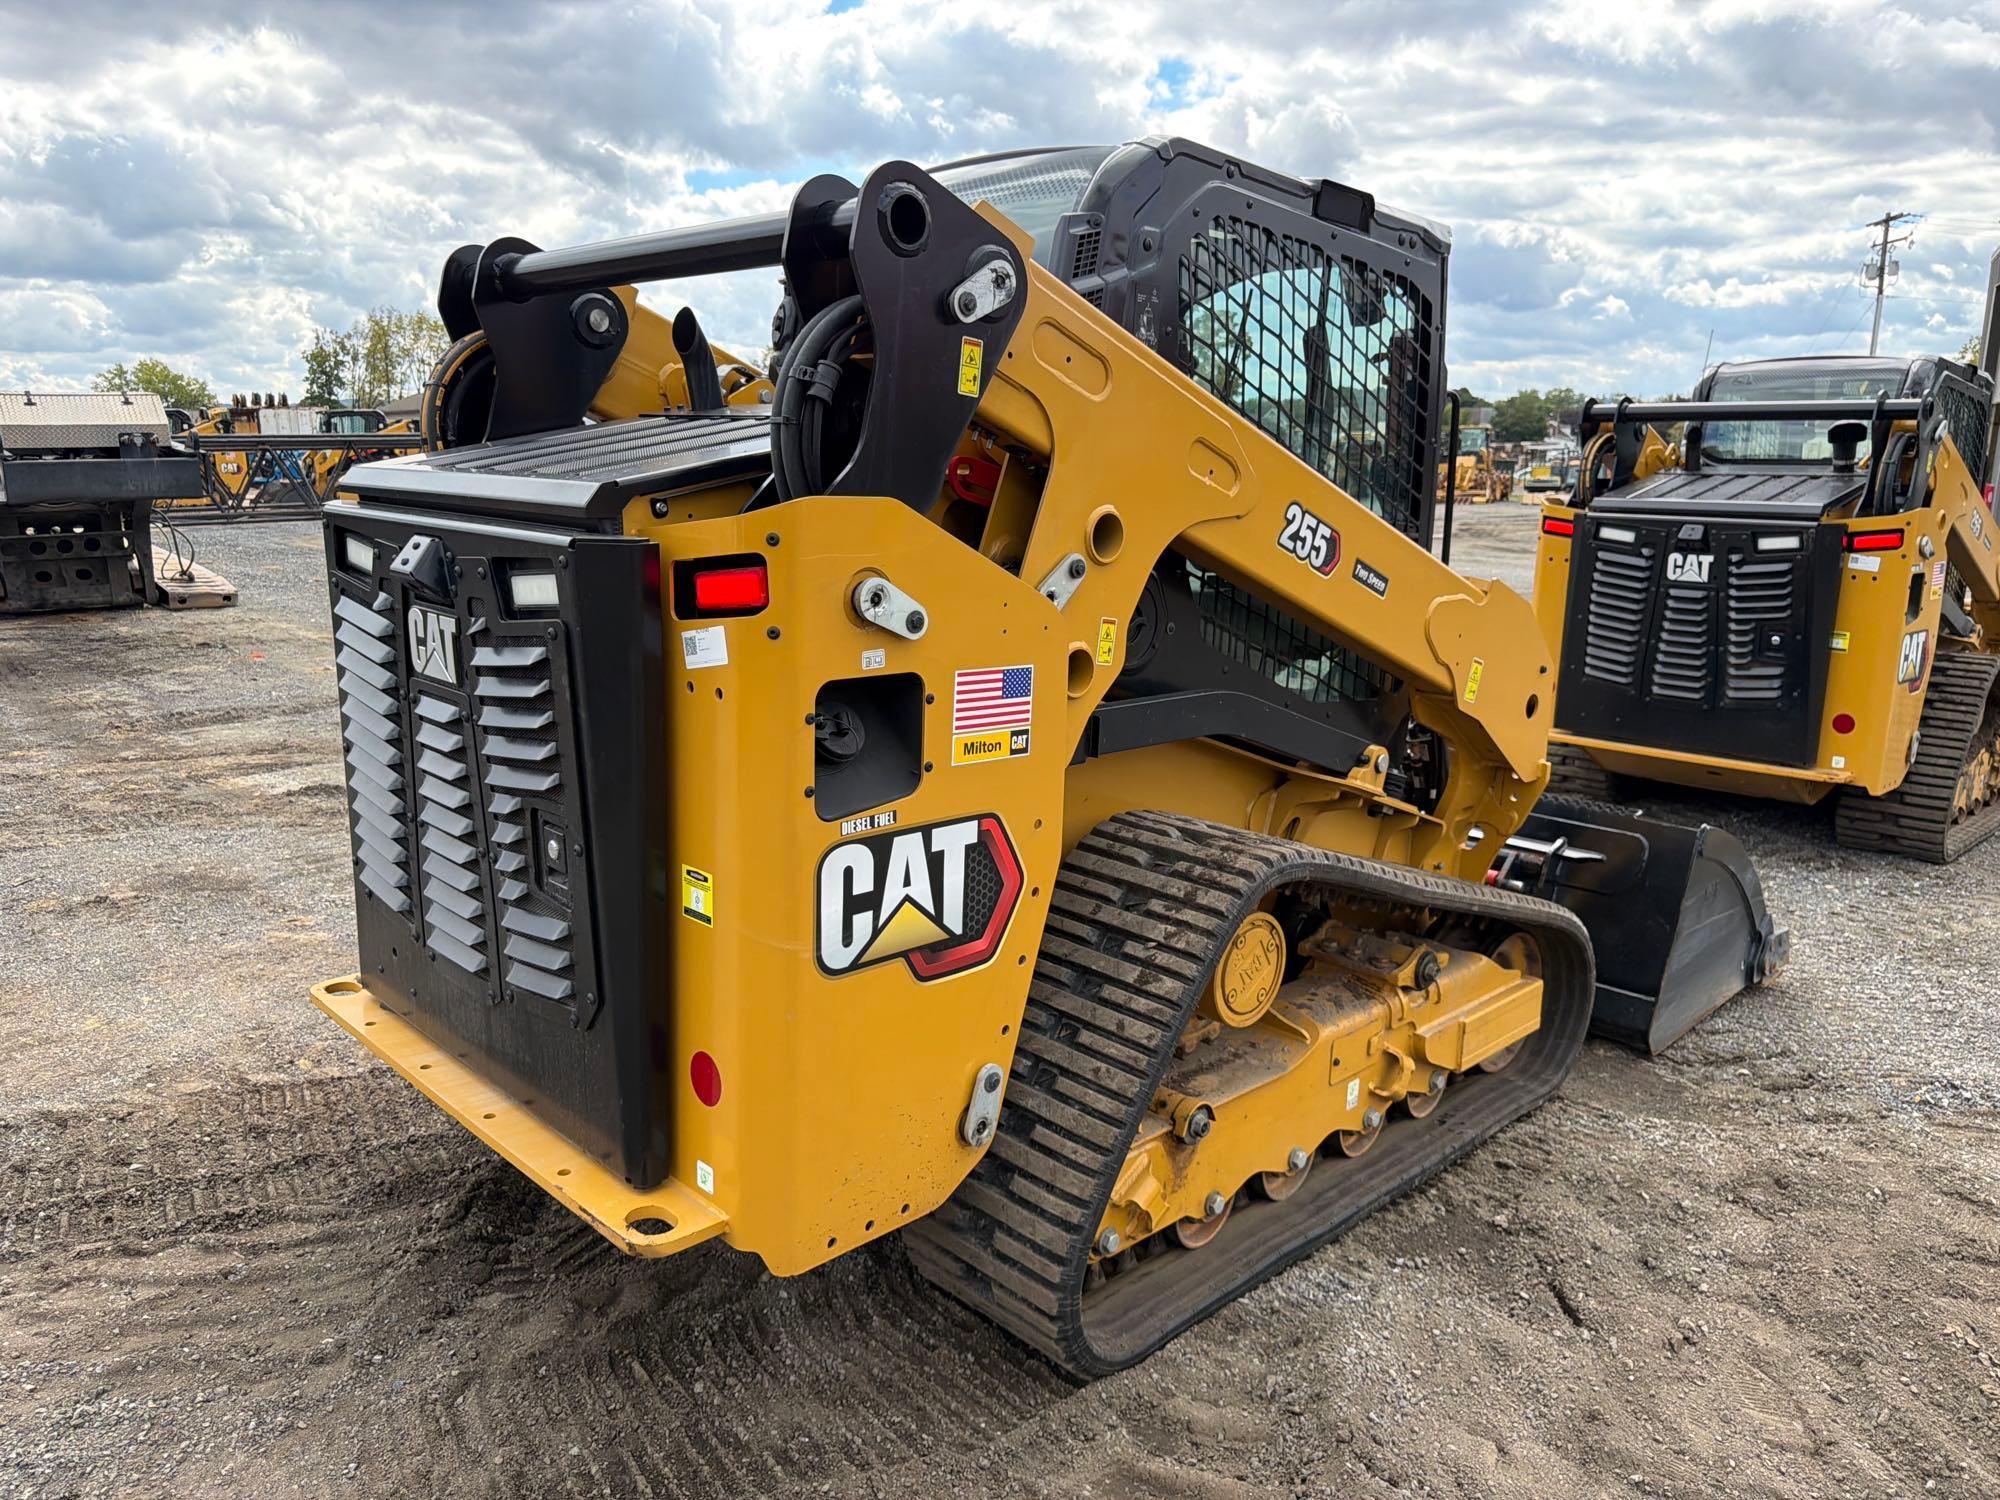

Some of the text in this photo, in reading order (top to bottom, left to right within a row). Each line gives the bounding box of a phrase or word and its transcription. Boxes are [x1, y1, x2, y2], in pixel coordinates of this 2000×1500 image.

[221, 463, 238, 473] CAT
[1278, 503, 1332, 568] 255
[1666, 552, 1715, 583] CAT
[408, 606, 457, 684] CAT
[1898, 631, 1926, 683] CAT
[963, 734, 1028, 756] Milton CAT
[841, 811, 895, 836] DIESEL FUEL
[819, 818, 980, 971] CAT
